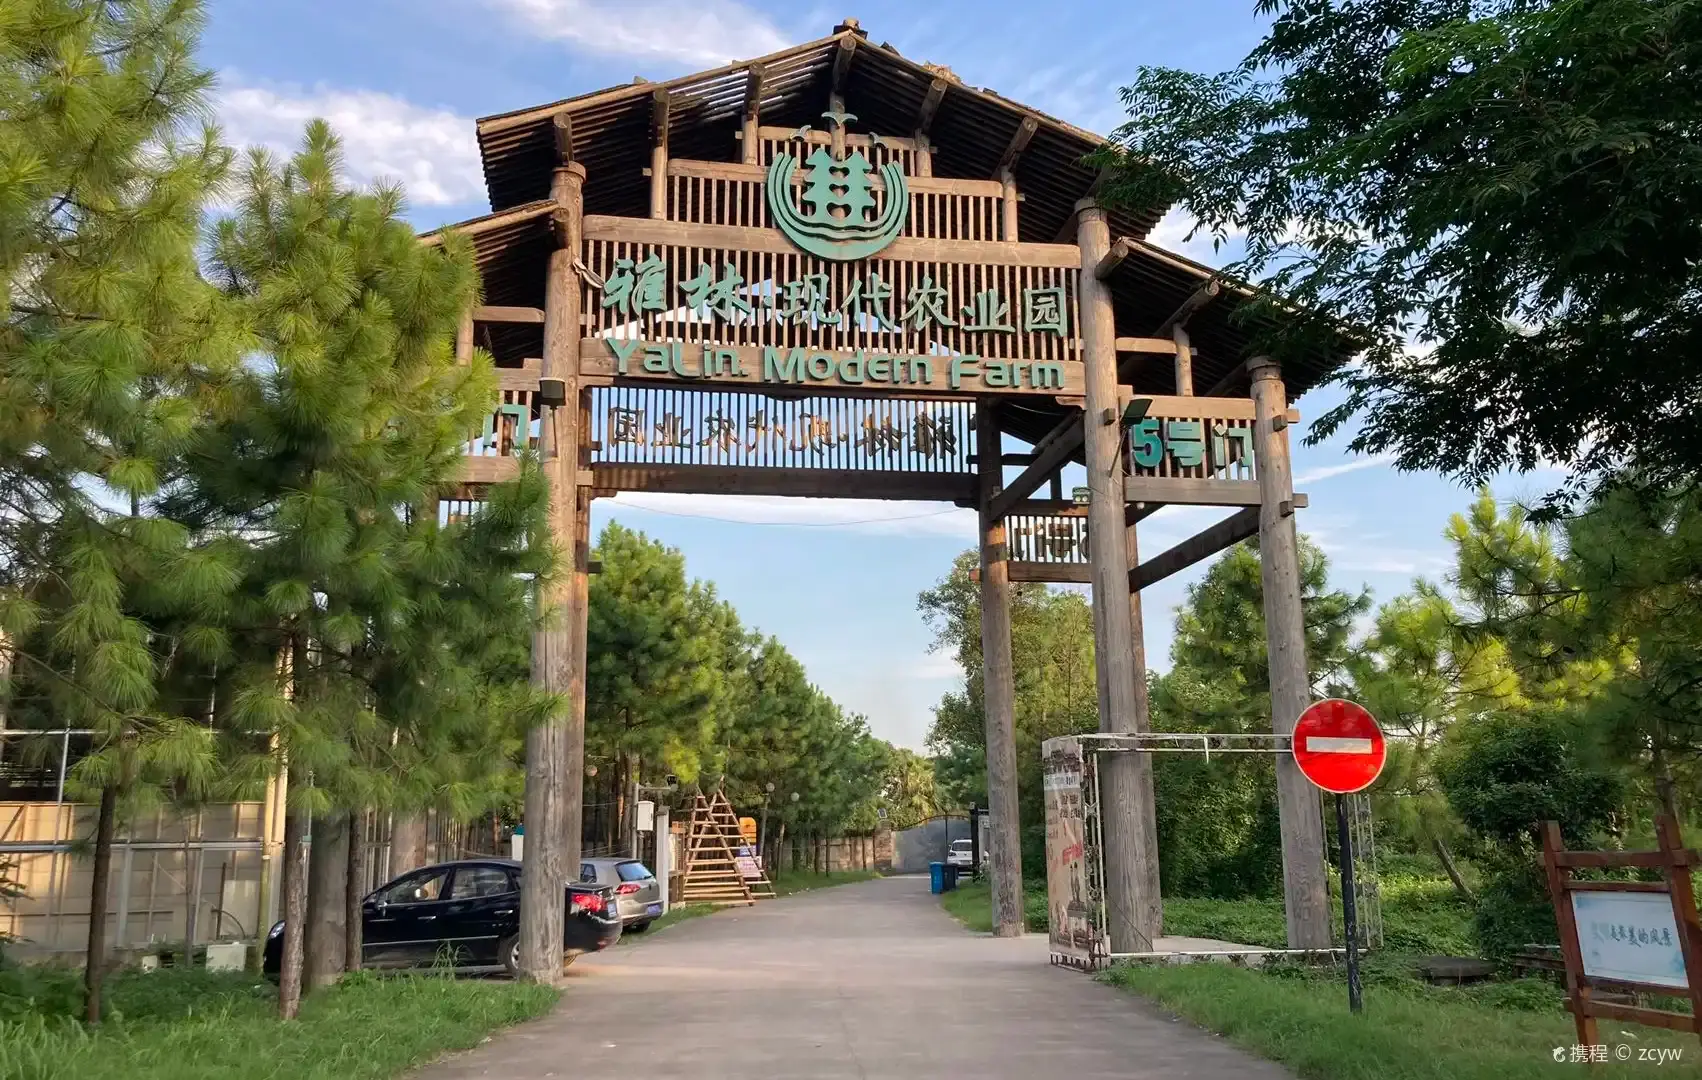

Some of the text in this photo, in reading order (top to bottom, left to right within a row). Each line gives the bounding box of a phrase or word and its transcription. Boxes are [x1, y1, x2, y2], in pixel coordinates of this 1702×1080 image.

[764, 344, 933, 384] Modern
[951, 355, 1065, 389] Farm
[1133, 418, 1253, 468] 5号门
